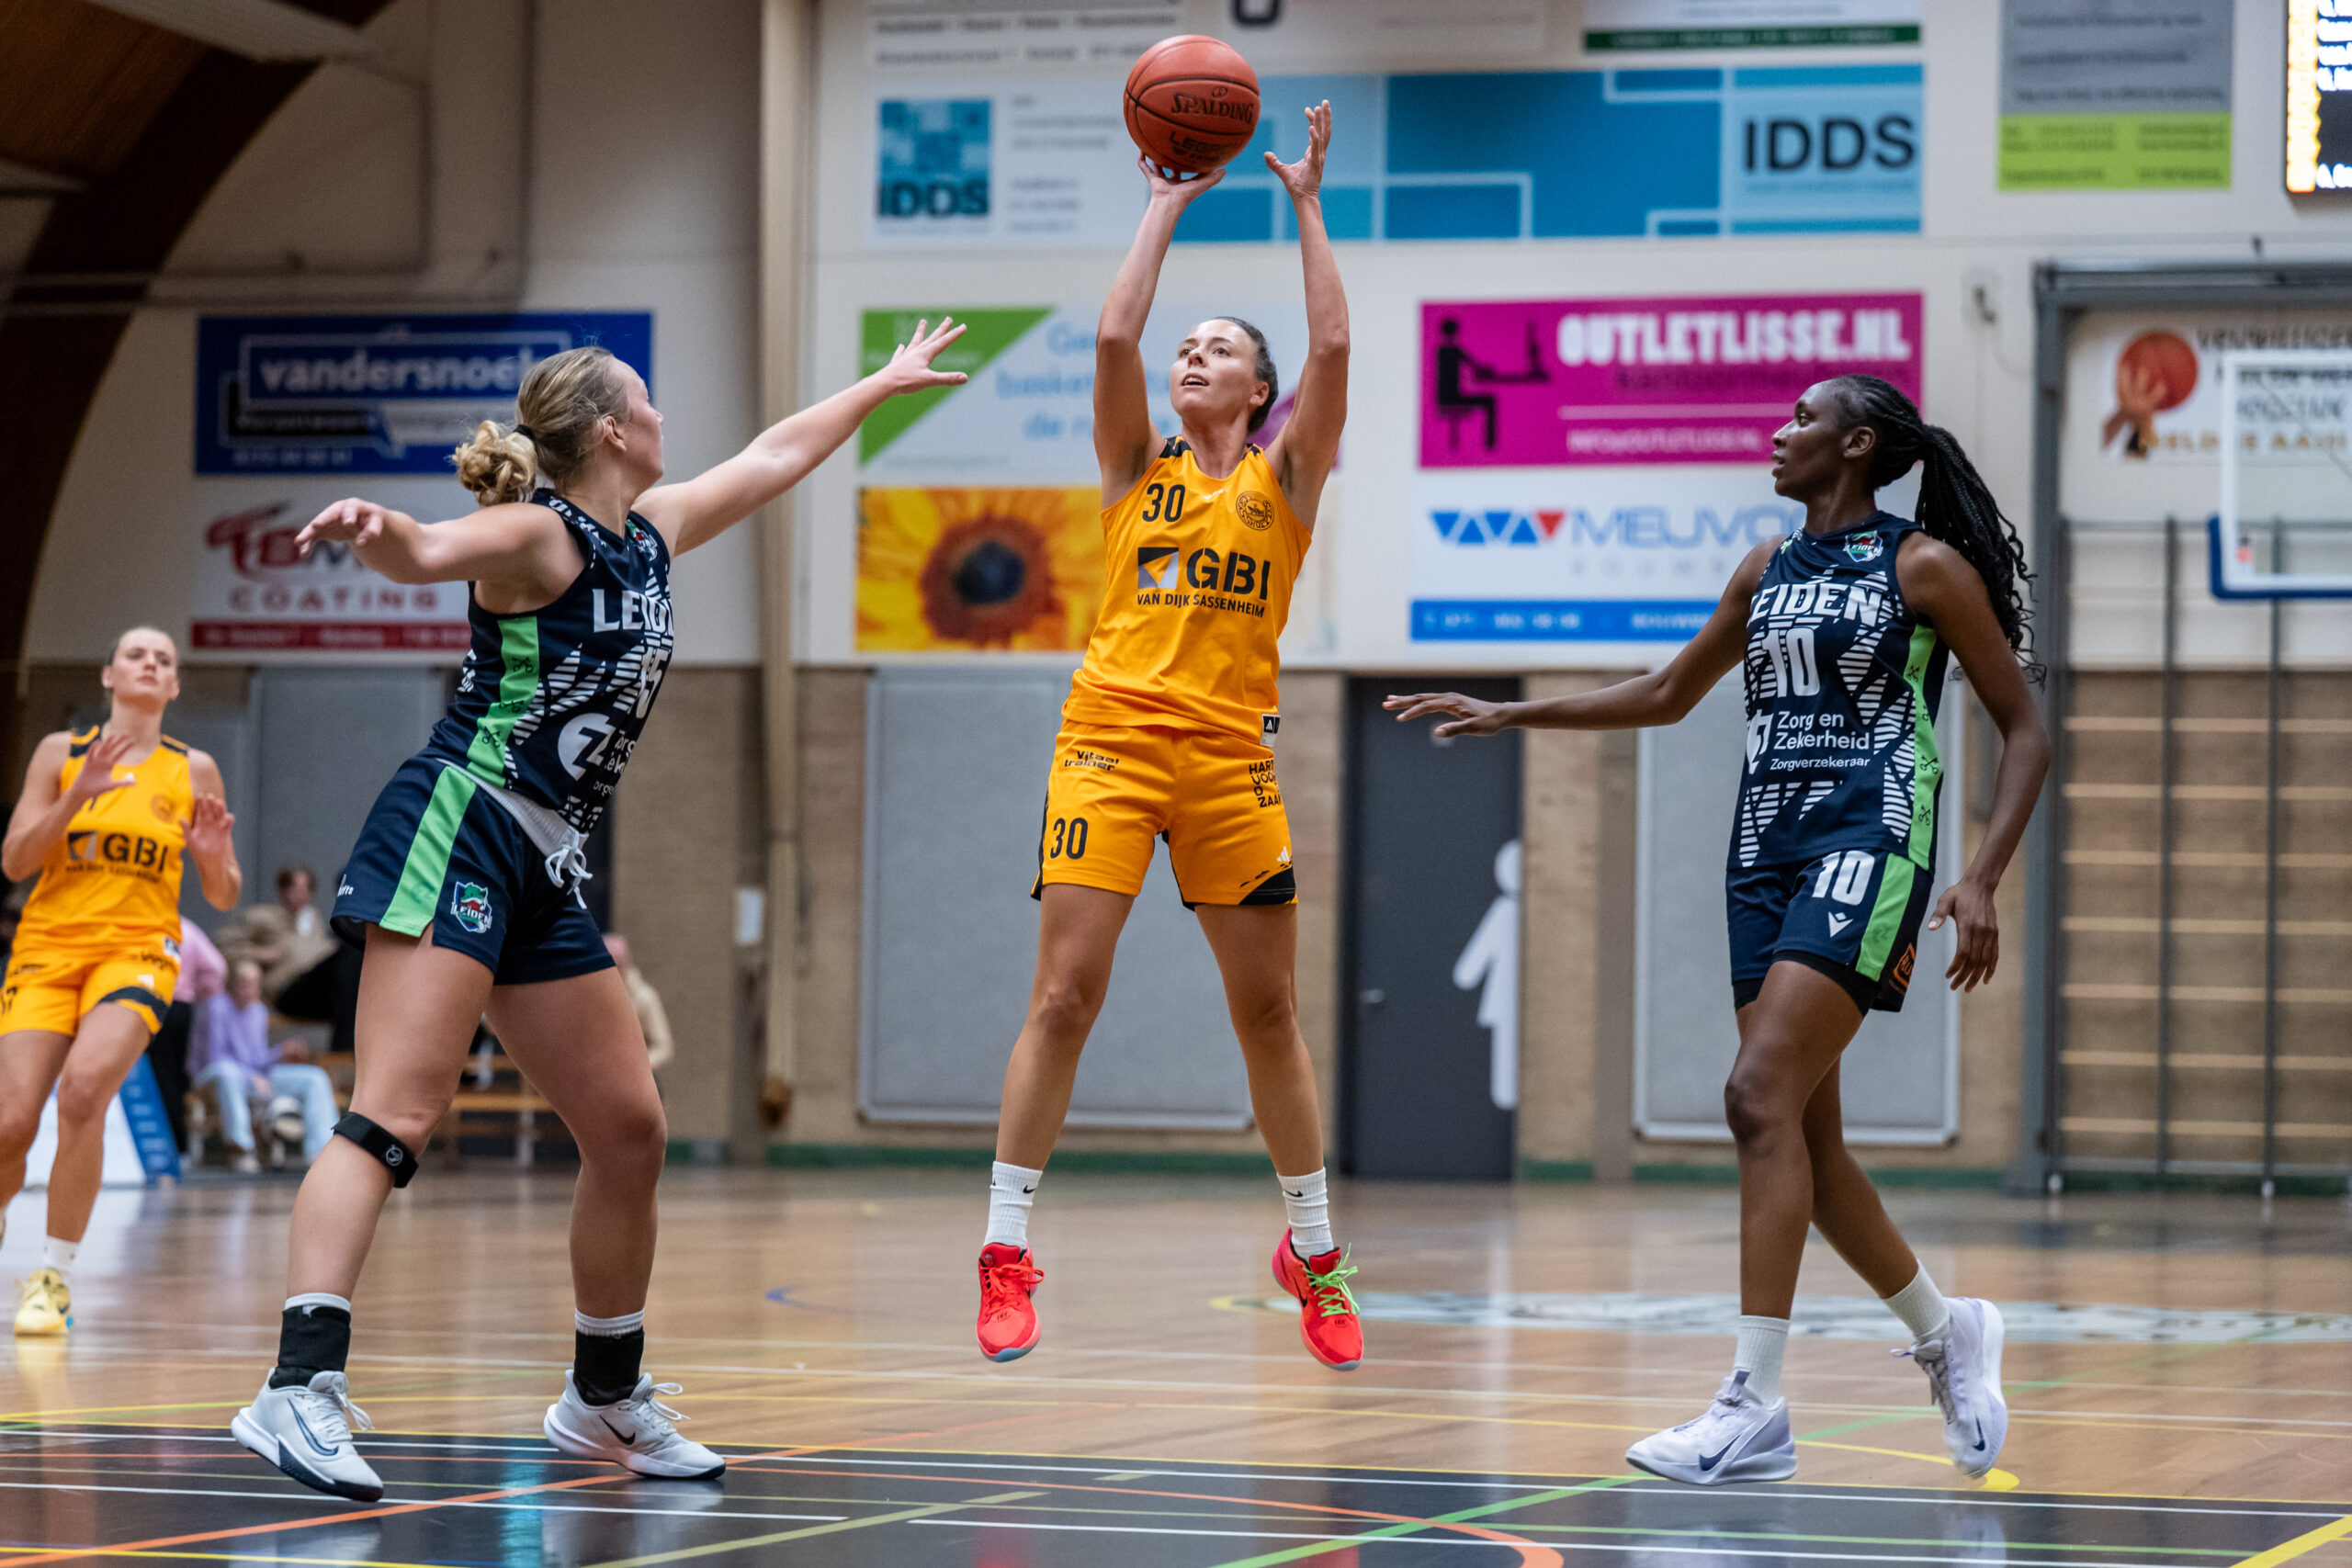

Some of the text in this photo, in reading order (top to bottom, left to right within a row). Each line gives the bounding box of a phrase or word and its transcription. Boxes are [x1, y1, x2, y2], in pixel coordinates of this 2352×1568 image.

[1171, 93, 1254, 125] SPALDING
[1747, 115, 1915, 173] IDDS
[877, 182, 989, 218] IDDS
[1558, 309, 1911, 365] OUTLETLISSE.NL
[1142, 483, 1186, 523] 30
[1186, 547, 1272, 600] GBI
[1137, 593, 1265, 618] VAN DIJK SASSENHEIM
[1761, 626, 1820, 698] 10
[1777, 710, 1845, 730] Zorg en
[1076, 750, 1119, 764] Vitaal
[1773, 730, 1870, 750] Zekerheid
[1064, 759, 1115, 772] trainer
[1250, 773, 1277, 786] VOO
[1770, 756, 1871, 772] Zorgverzekeraar
[102, 832, 168, 874] GBI
[1049, 817, 1089, 860] 30
[1812, 850, 1876, 906] 10
[451, 902, 492, 928] LEIDEN
